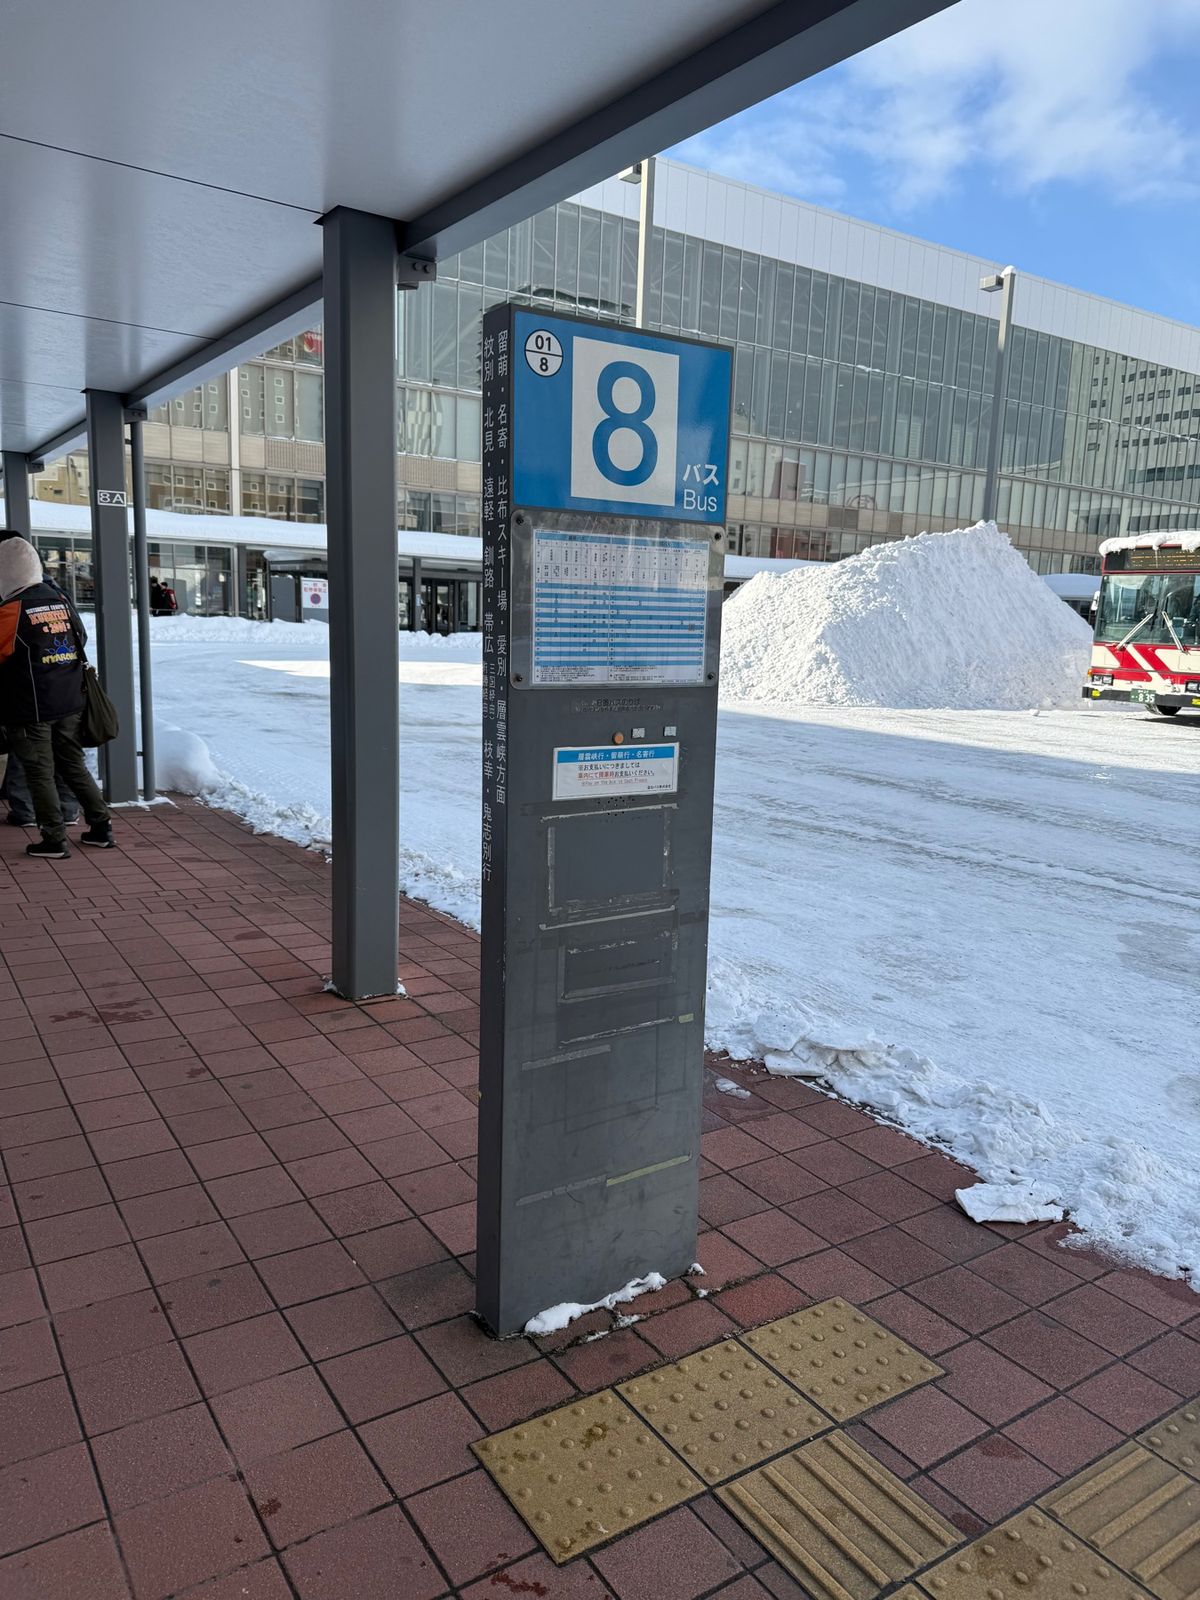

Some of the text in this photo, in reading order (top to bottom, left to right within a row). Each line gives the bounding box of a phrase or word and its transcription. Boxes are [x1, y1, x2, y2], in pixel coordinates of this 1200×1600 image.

[534, 334, 552, 353] 01
[539, 357, 549, 374] 8
[591, 360, 659, 487] 8
[682, 463, 719, 486] バス
[100, 492, 124, 504] 8A
[683, 489, 718, 513] Bus
